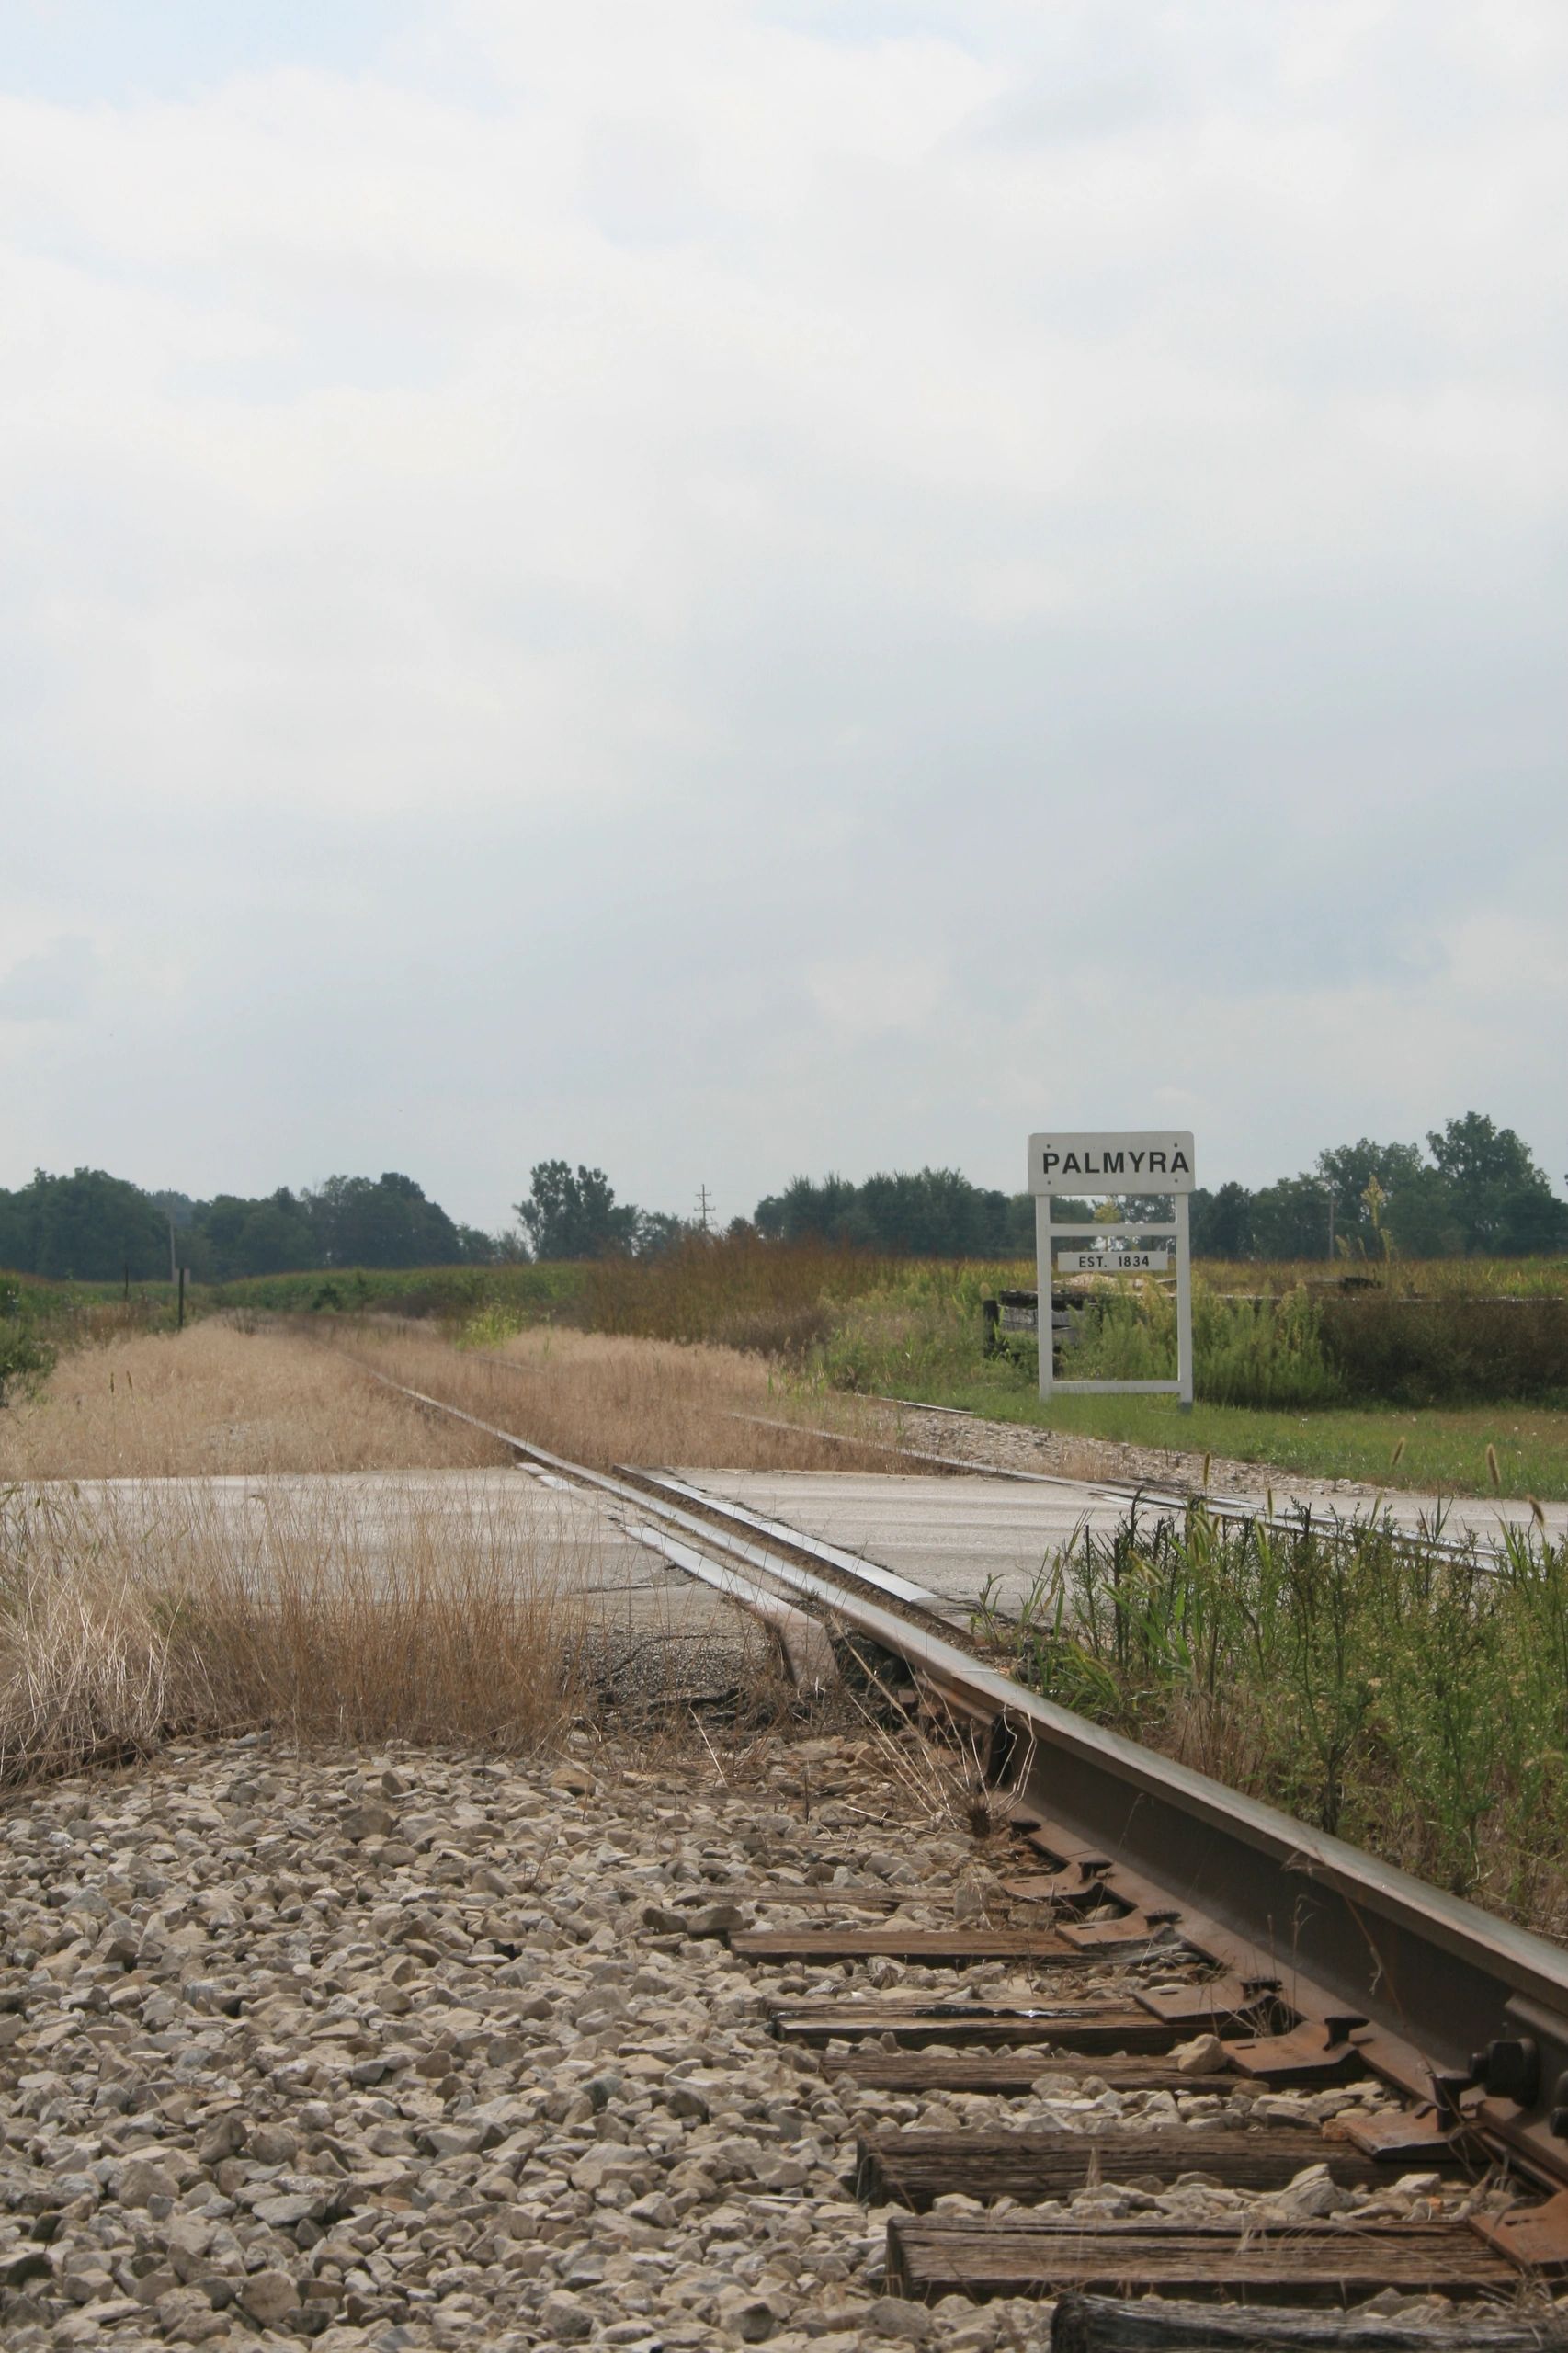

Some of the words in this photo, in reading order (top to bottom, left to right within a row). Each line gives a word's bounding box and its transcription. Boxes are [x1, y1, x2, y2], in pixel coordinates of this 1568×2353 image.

[1043, 1151, 1190, 1174] PALMYRA
[1079, 1256, 1108, 1268] EST.
[1119, 1256, 1150, 1267] 1834
